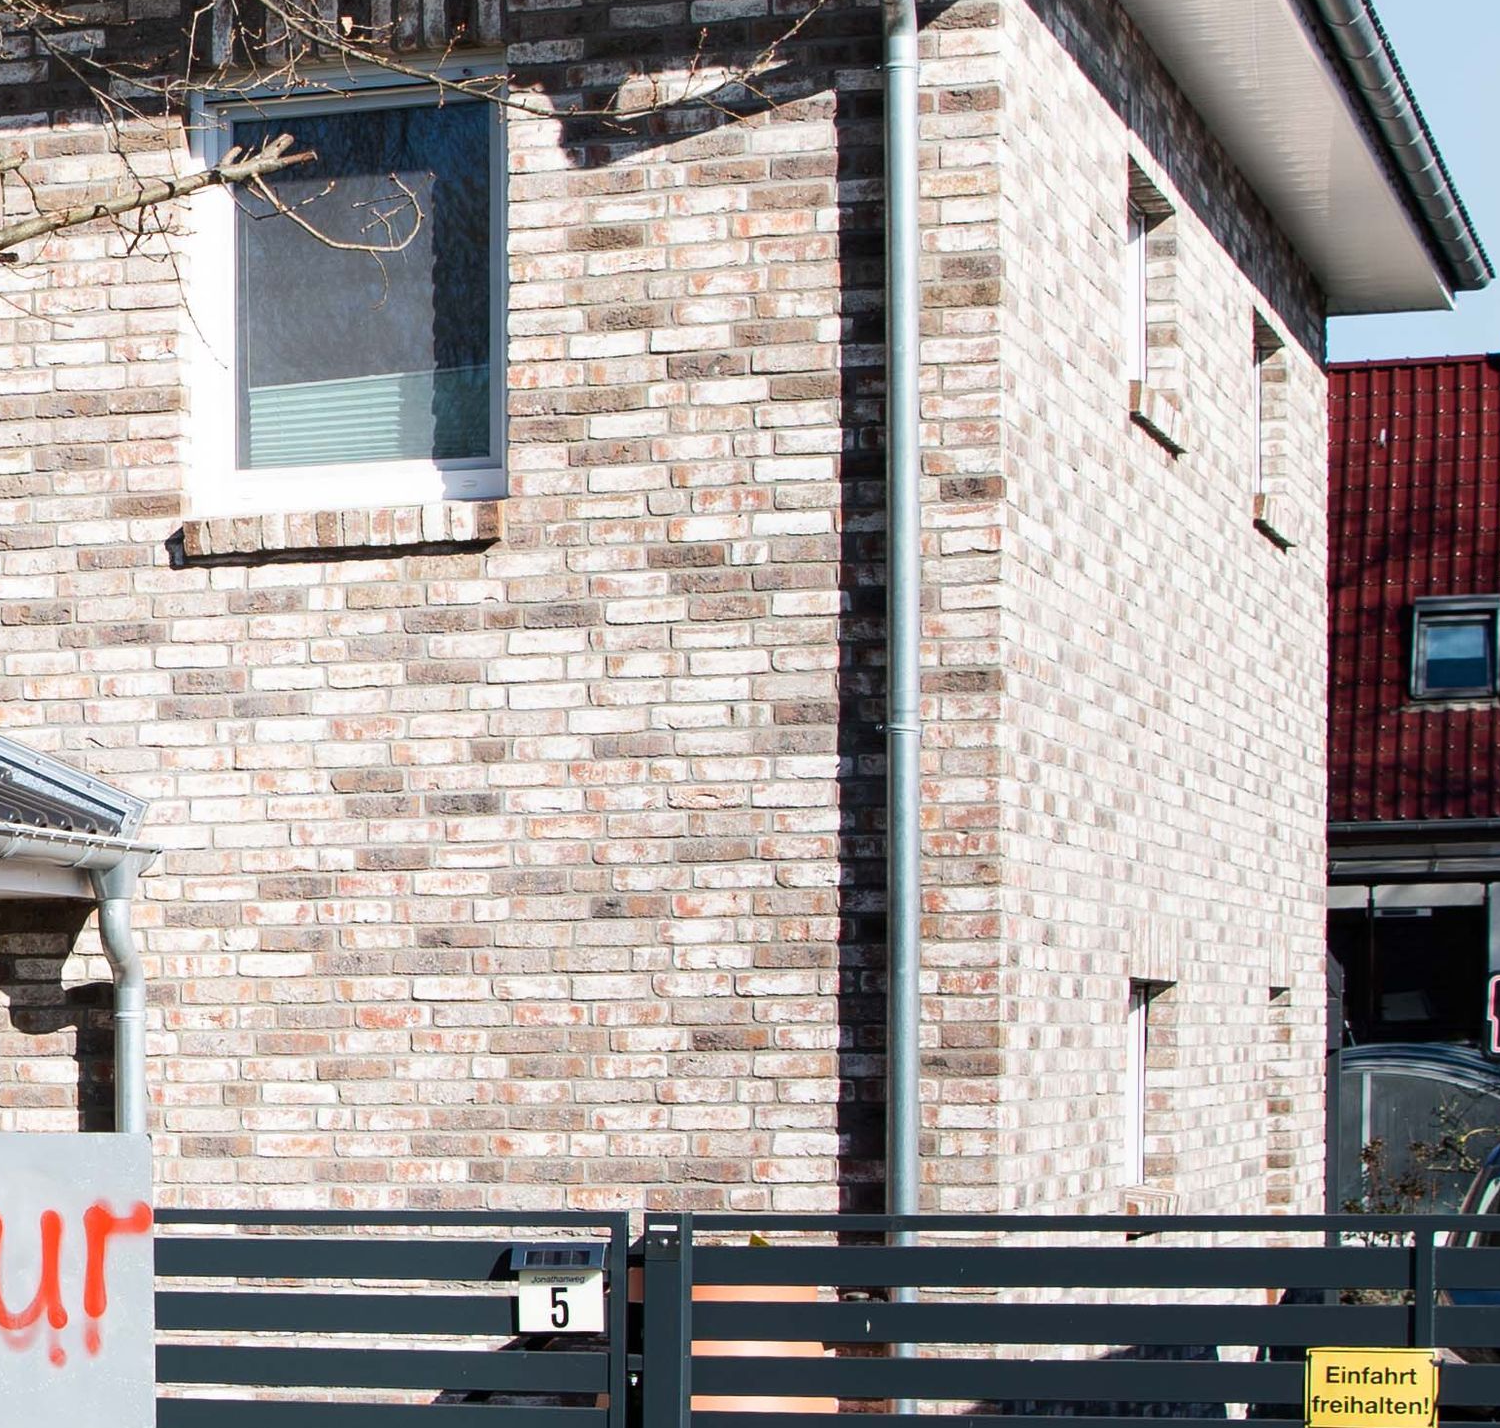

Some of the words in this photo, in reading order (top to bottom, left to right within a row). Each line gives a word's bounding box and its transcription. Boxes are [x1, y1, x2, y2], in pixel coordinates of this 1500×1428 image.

[551, 1287, 569, 1328] 5
[1325, 1366, 1417, 1385] Einfahrt
[1311, 1396, 1429, 1414] freihalten!
